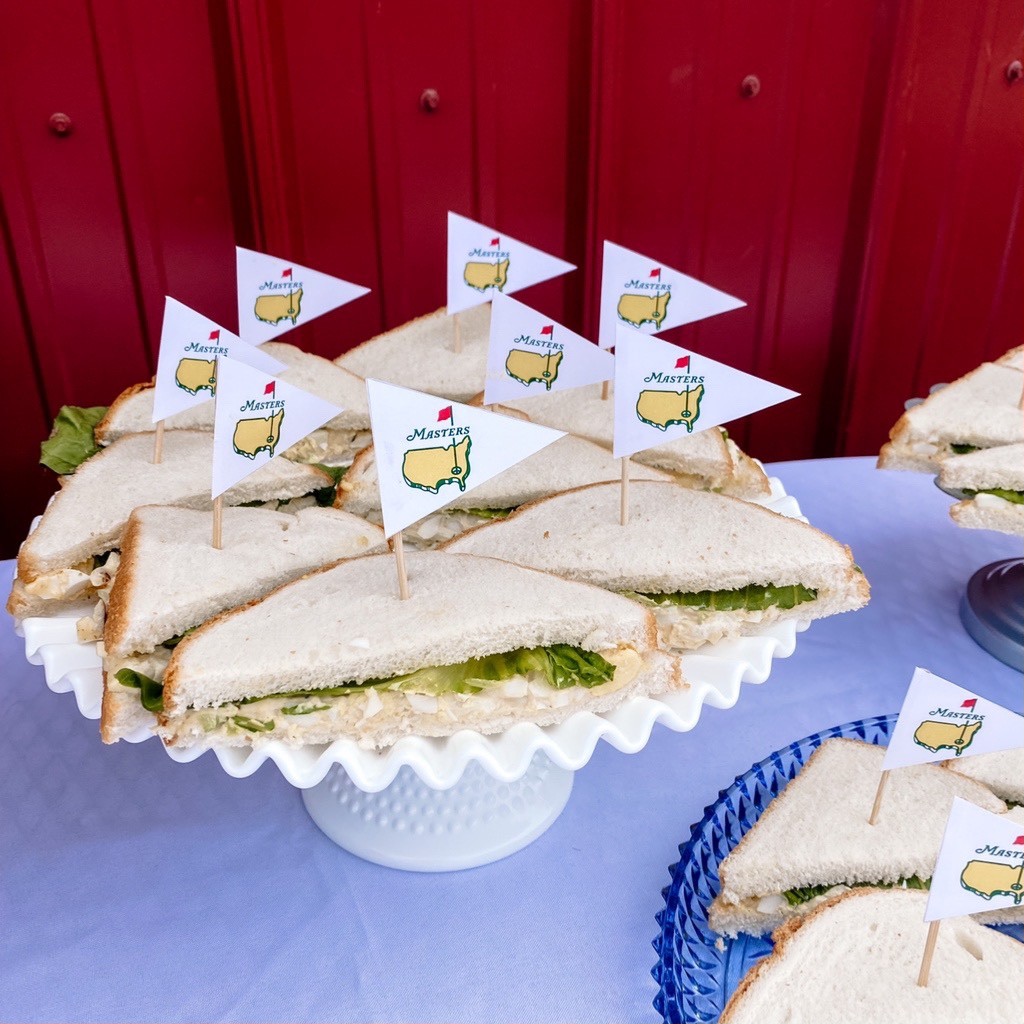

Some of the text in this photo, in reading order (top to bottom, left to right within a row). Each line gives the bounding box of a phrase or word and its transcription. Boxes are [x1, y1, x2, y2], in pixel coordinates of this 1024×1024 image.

[468, 248, 510, 258] MASTERS
[258, 280, 303, 290] MASTERS
[624, 279, 671, 291] MASTERS
[184, 342, 228, 354] MASTERS
[514, 335, 565, 350] MASTERS
[644, 372, 705, 384] MASTERS
[240, 399, 286, 412] MASTERS
[406, 426, 471, 441] MASTERS
[929, 707, 985, 721] MASTERS
